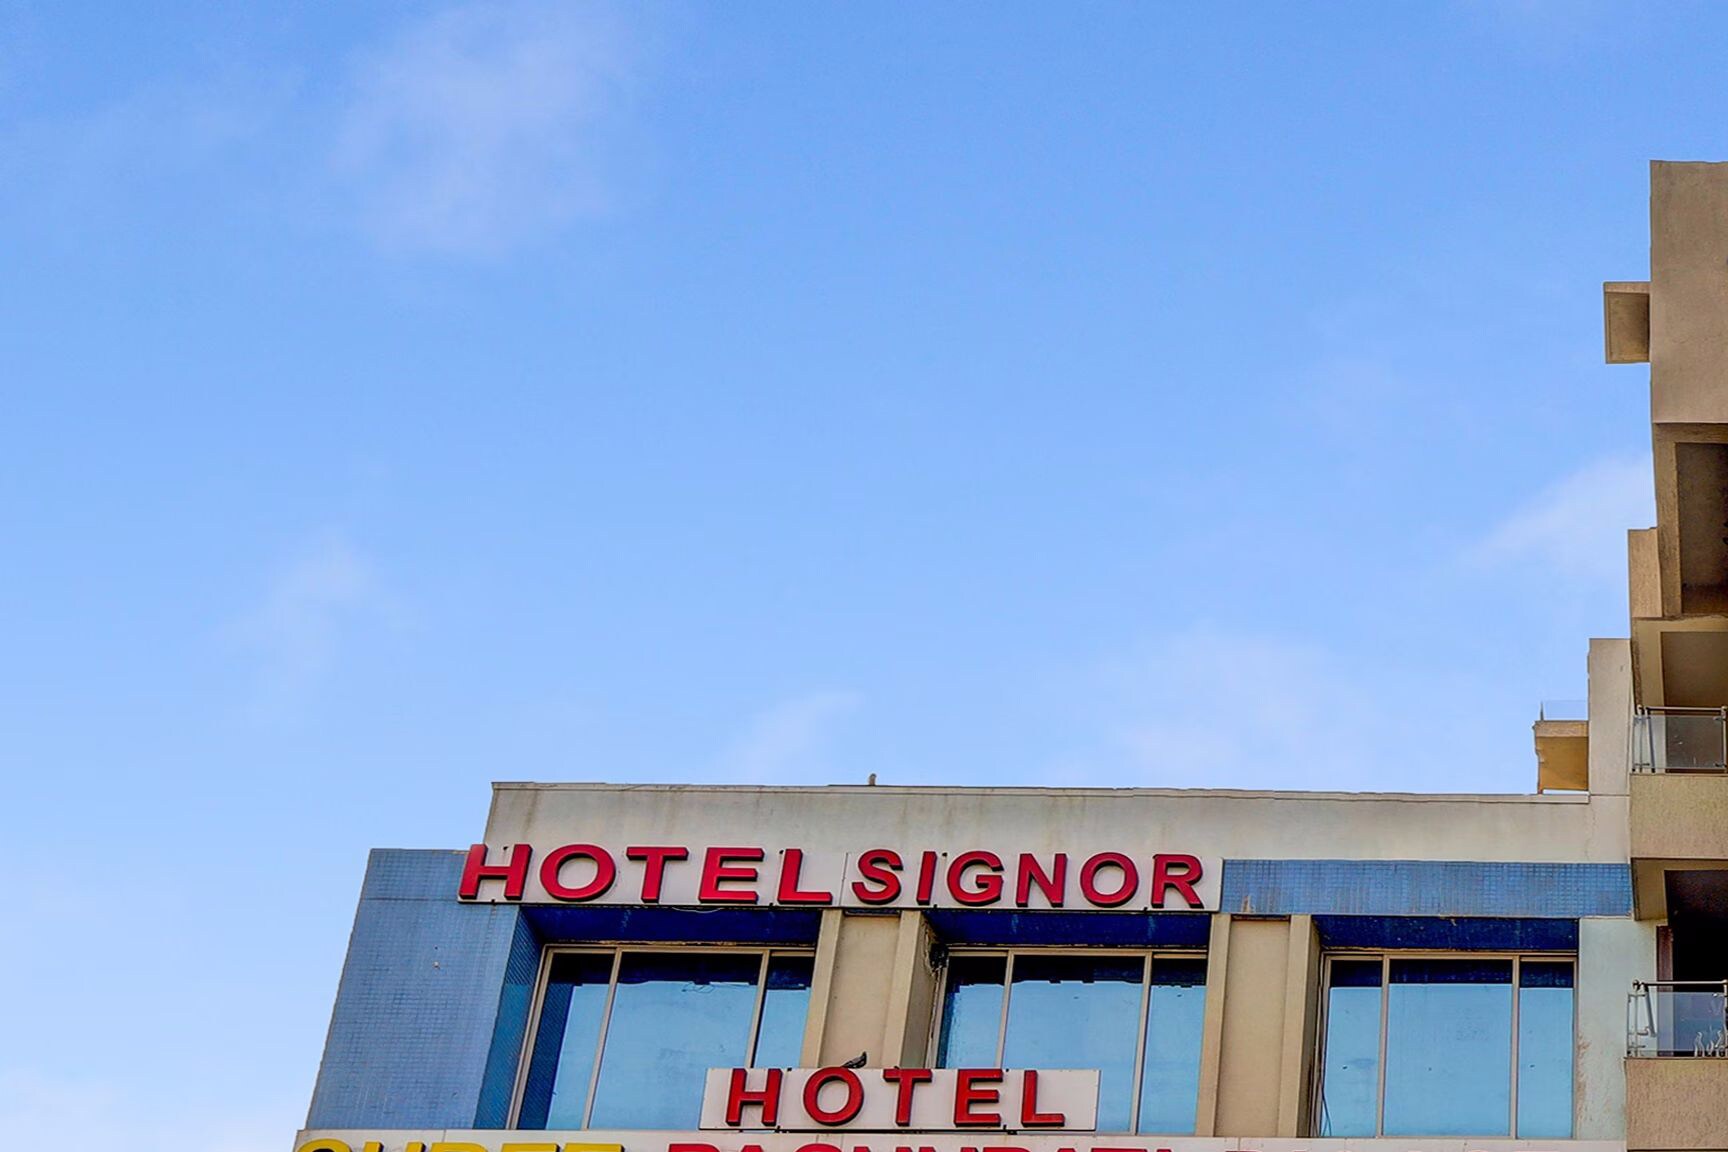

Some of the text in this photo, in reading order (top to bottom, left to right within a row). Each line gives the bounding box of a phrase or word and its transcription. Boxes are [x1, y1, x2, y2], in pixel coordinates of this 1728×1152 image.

[457, 843, 1206, 909] HOTEL SIGNOR
[724, 1066, 1066, 1128] HOTEL
